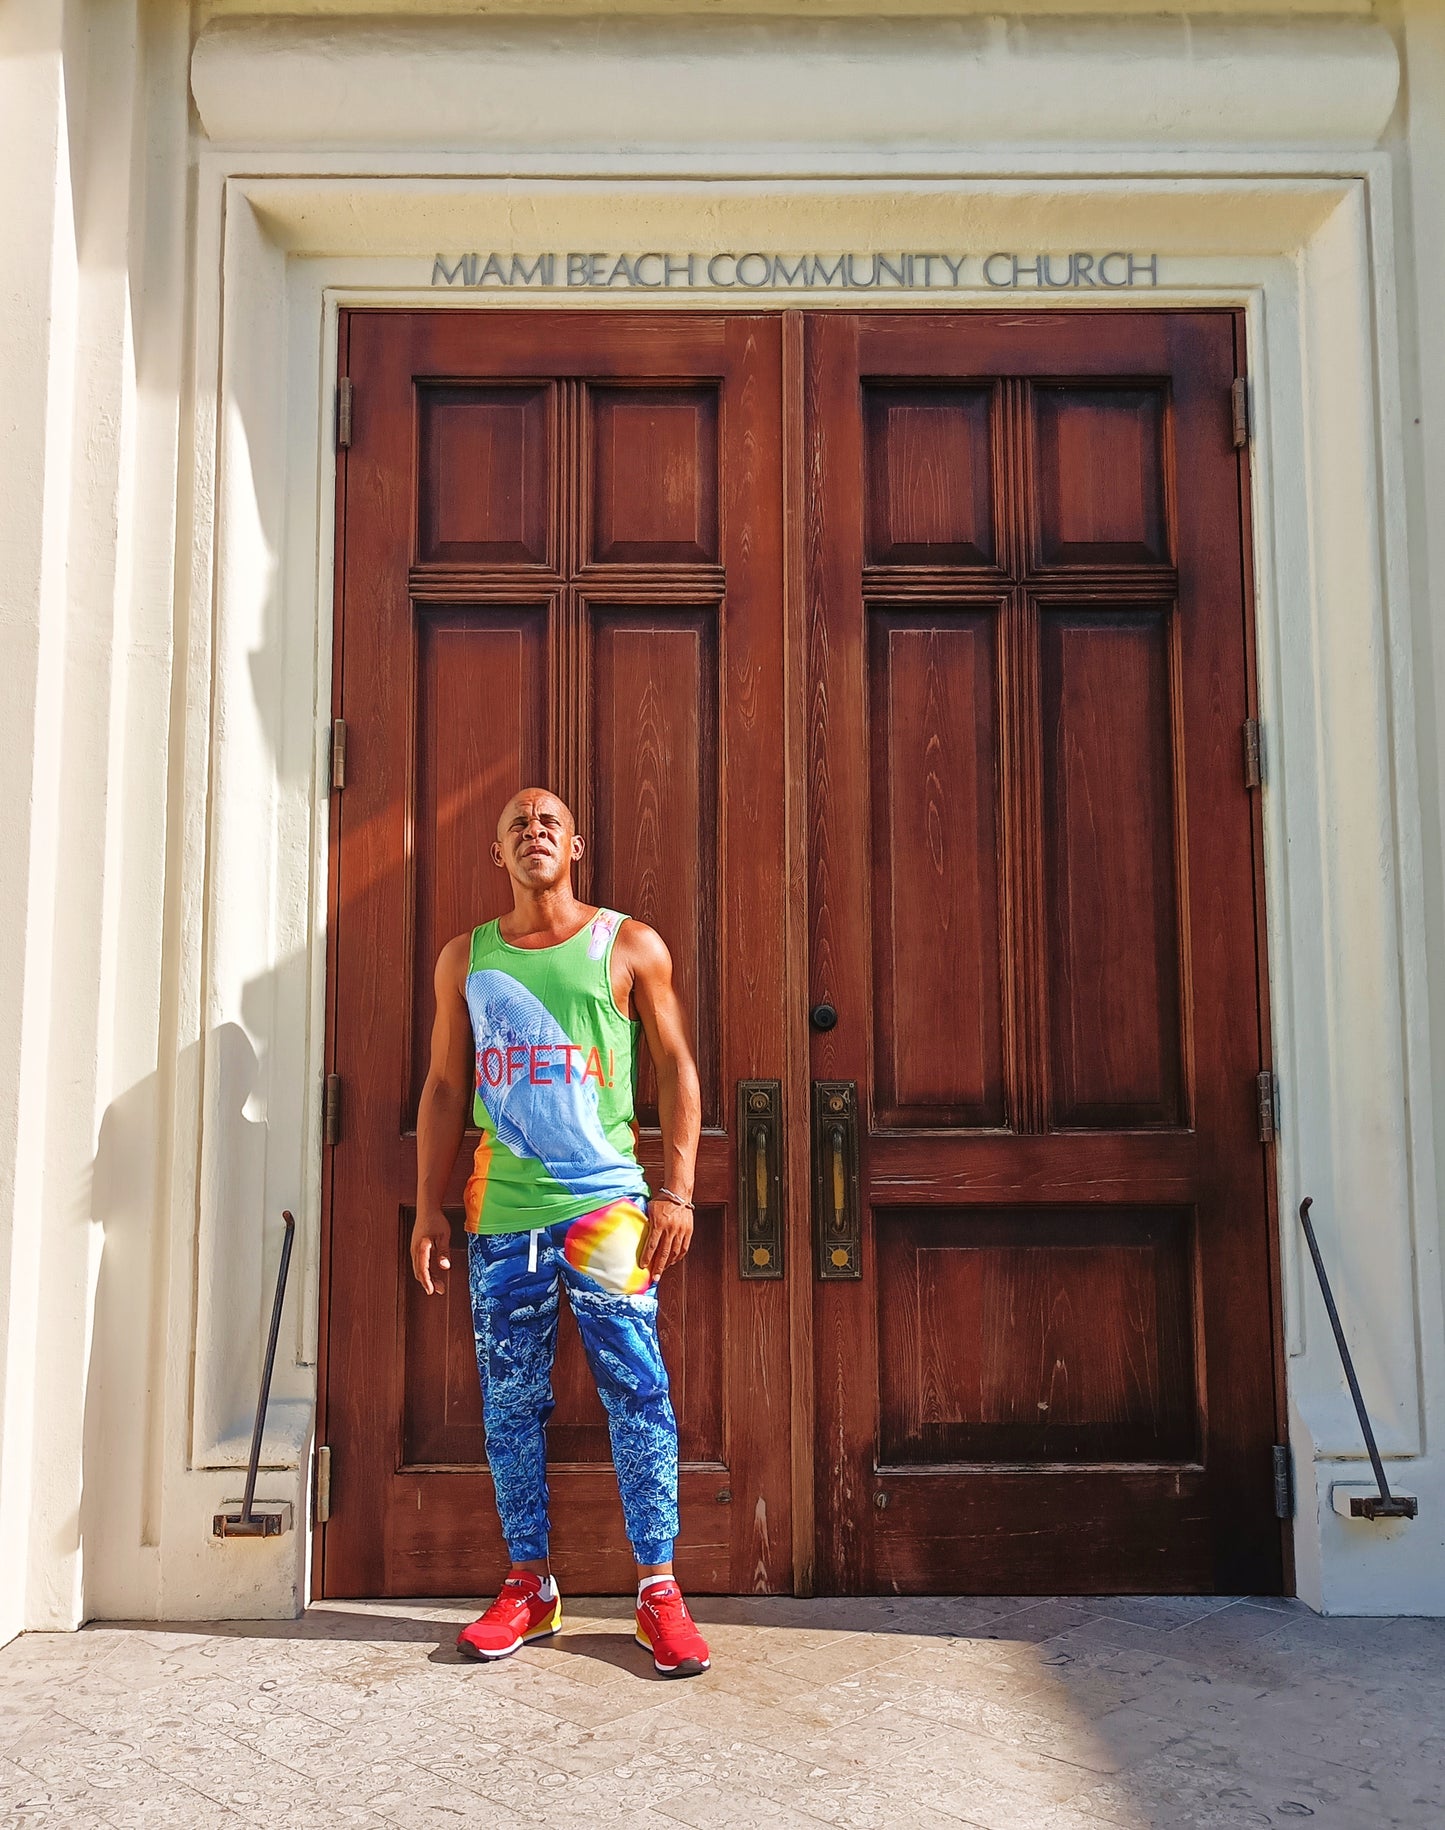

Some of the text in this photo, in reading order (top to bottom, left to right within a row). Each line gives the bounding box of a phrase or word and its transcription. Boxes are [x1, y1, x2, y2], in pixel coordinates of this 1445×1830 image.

[431, 252, 1158, 287] MIAMI BEACH COMMUNITY CHURCH
